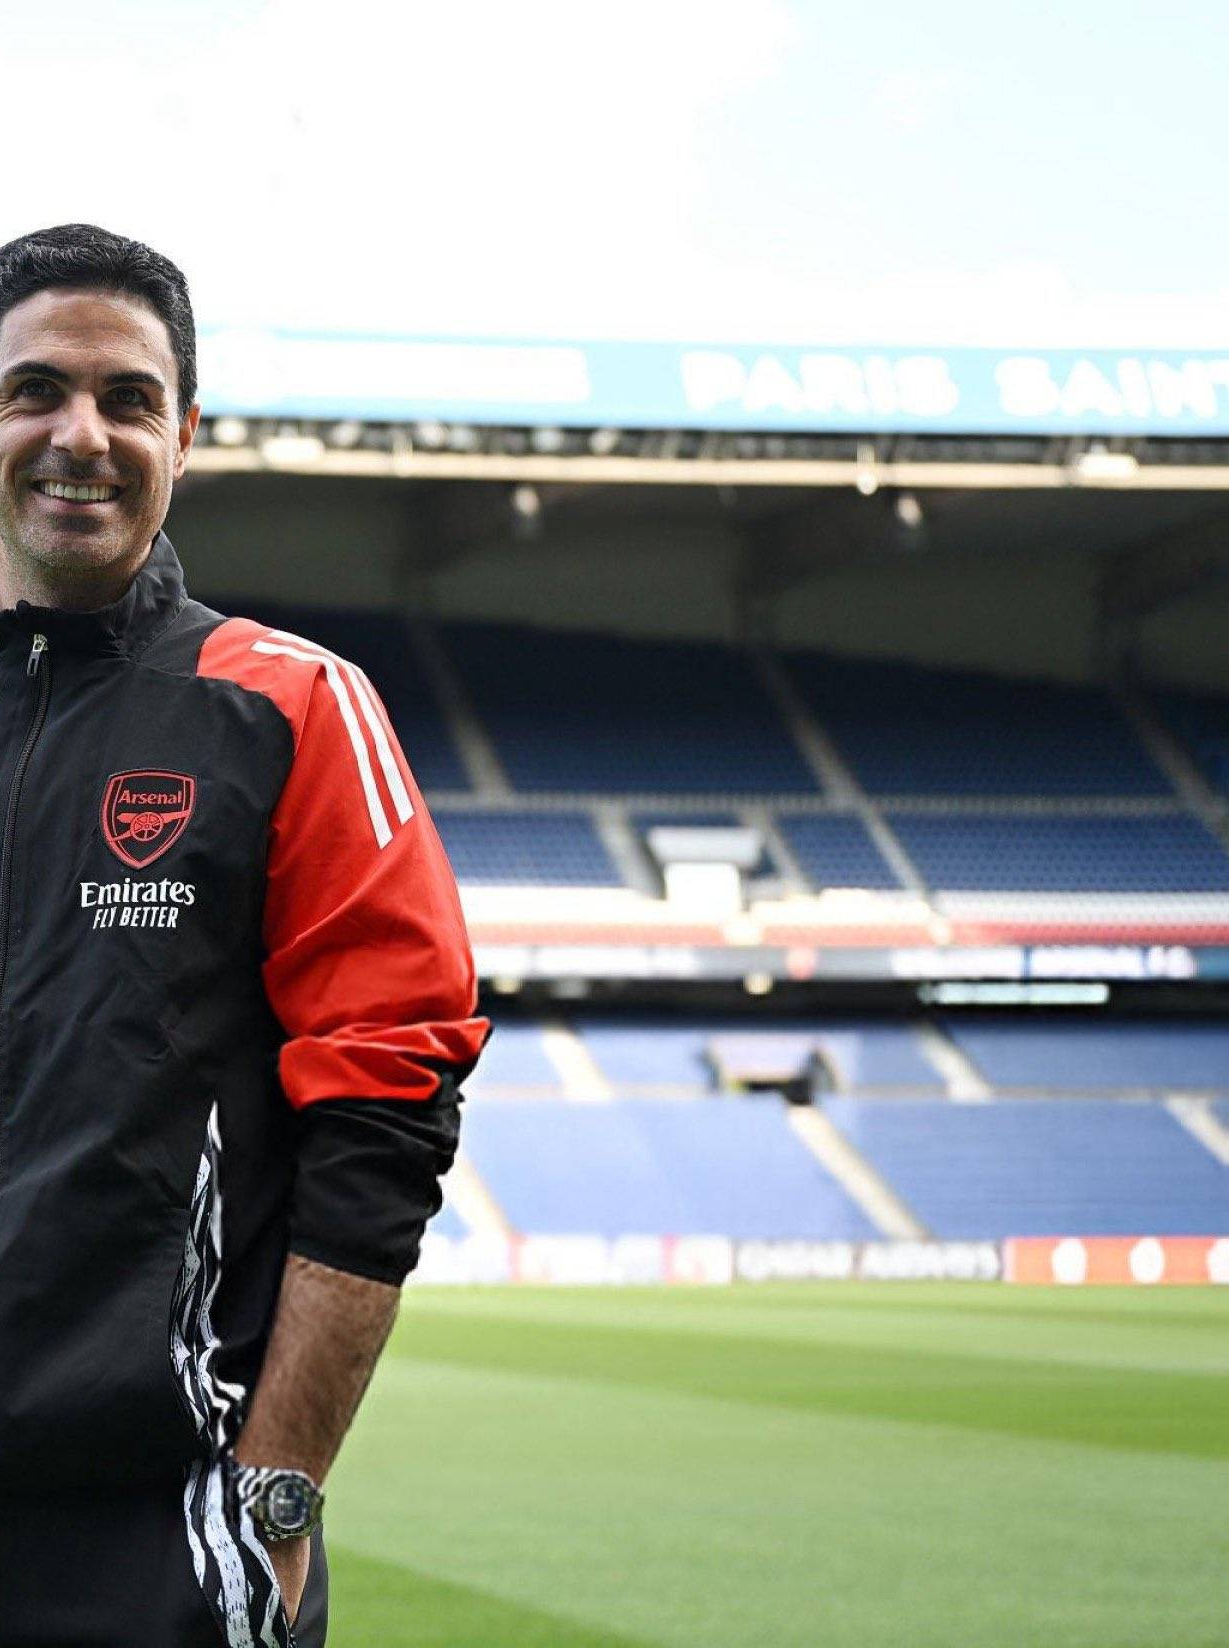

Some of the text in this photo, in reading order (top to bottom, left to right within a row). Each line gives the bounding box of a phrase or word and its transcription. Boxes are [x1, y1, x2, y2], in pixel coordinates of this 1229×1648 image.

[680, 350, 960, 417] PARIS
[118, 789, 182, 805] Arsenal
[80, 877, 196, 907] Emirates
[93, 906, 179, 930] FLY BETTER
